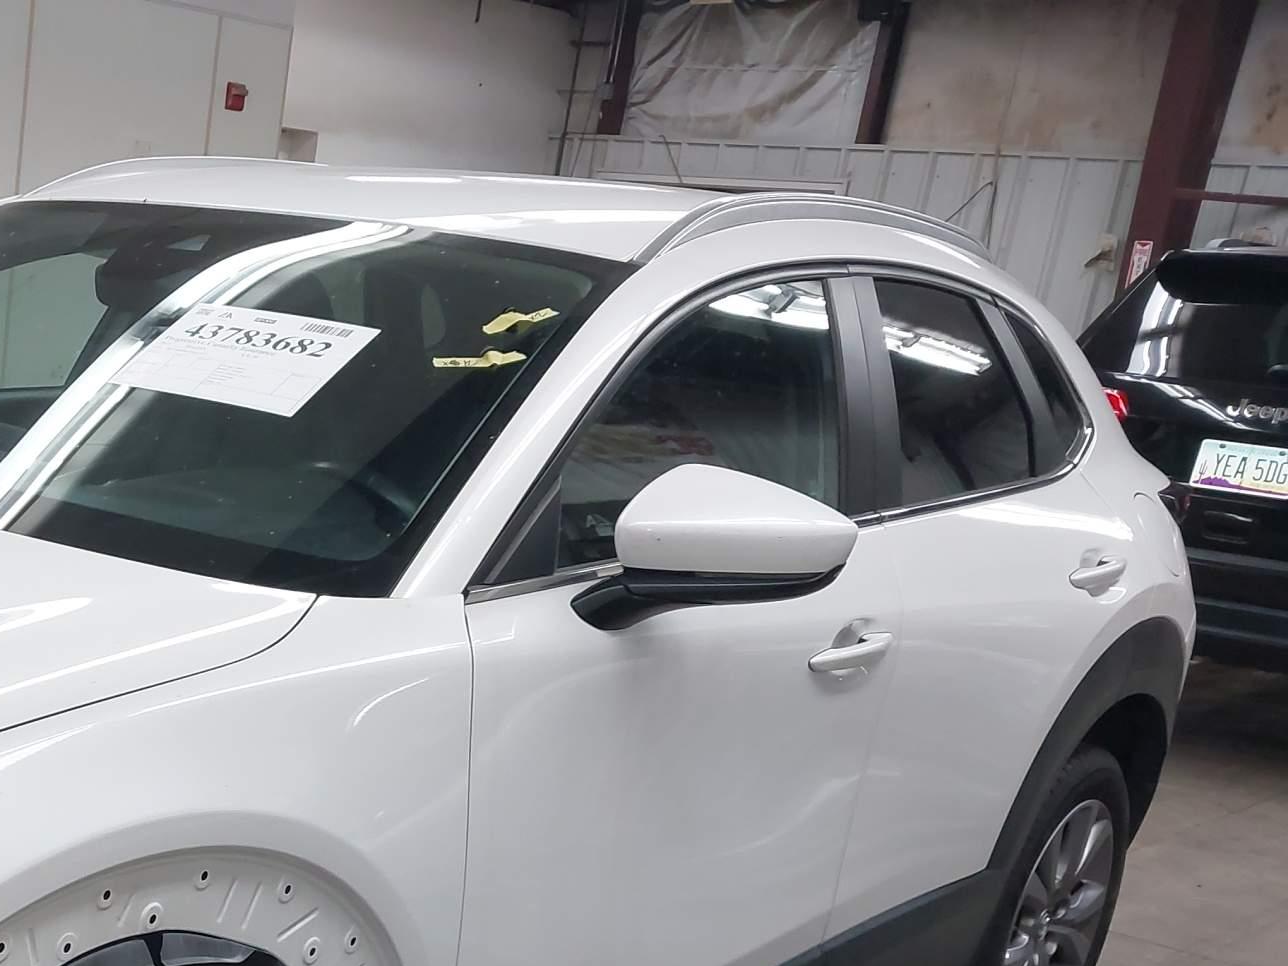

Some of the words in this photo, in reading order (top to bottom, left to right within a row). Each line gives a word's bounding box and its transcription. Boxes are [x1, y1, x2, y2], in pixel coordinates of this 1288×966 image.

[184, 322, 333, 358] 43783682
[1226, 398, 1288, 425] Jeep
[1213, 453, 1249, 479] YEA
[1252, 458, 1288, 485] 5DG
